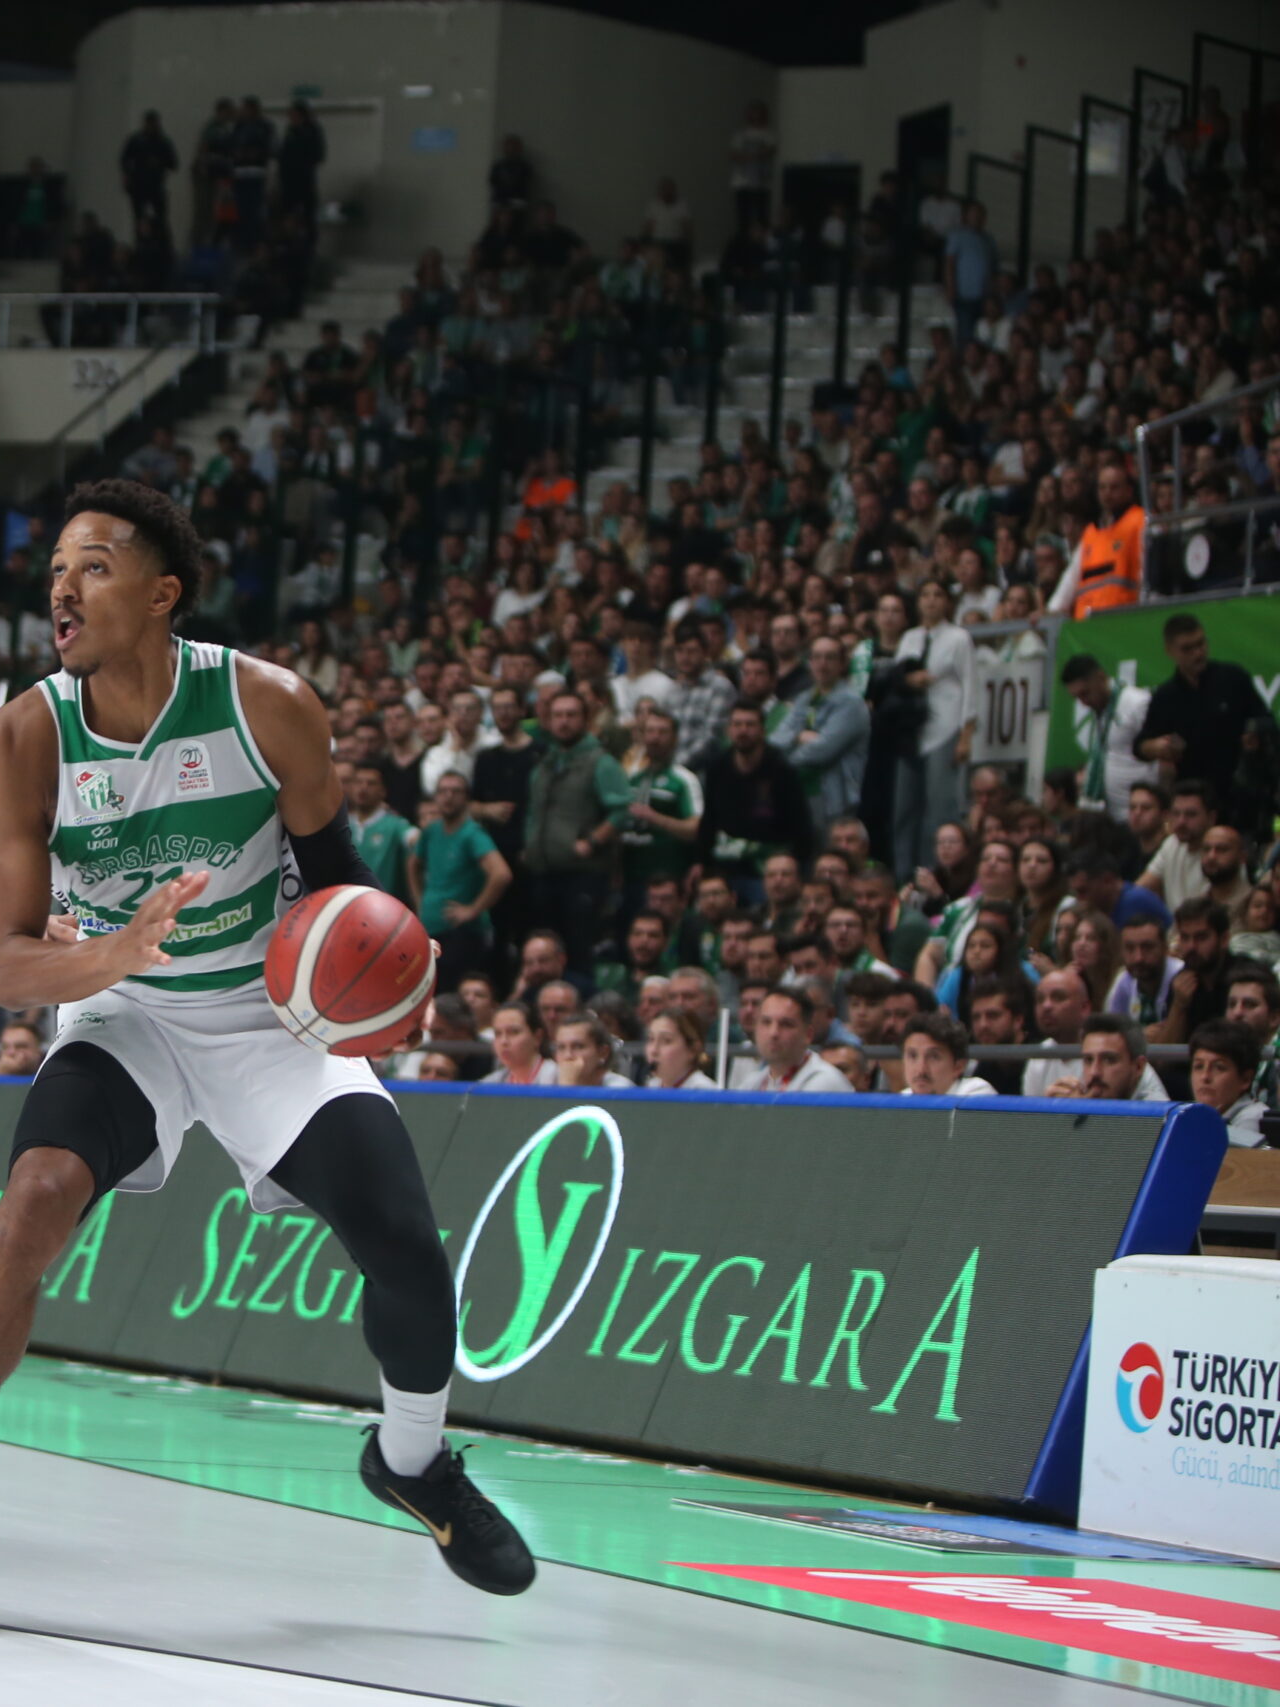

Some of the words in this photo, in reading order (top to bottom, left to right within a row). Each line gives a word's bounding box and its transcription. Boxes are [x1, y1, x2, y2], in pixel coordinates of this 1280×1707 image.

[986, 678, 1029, 745] 101
[586, 1246, 980, 1422] IZGARA
[1172, 1349, 1280, 1403] TÜRKİY
[1171, 1446, 1223, 1488] Gücü,
[1227, 1453, 1280, 1491] adınd
